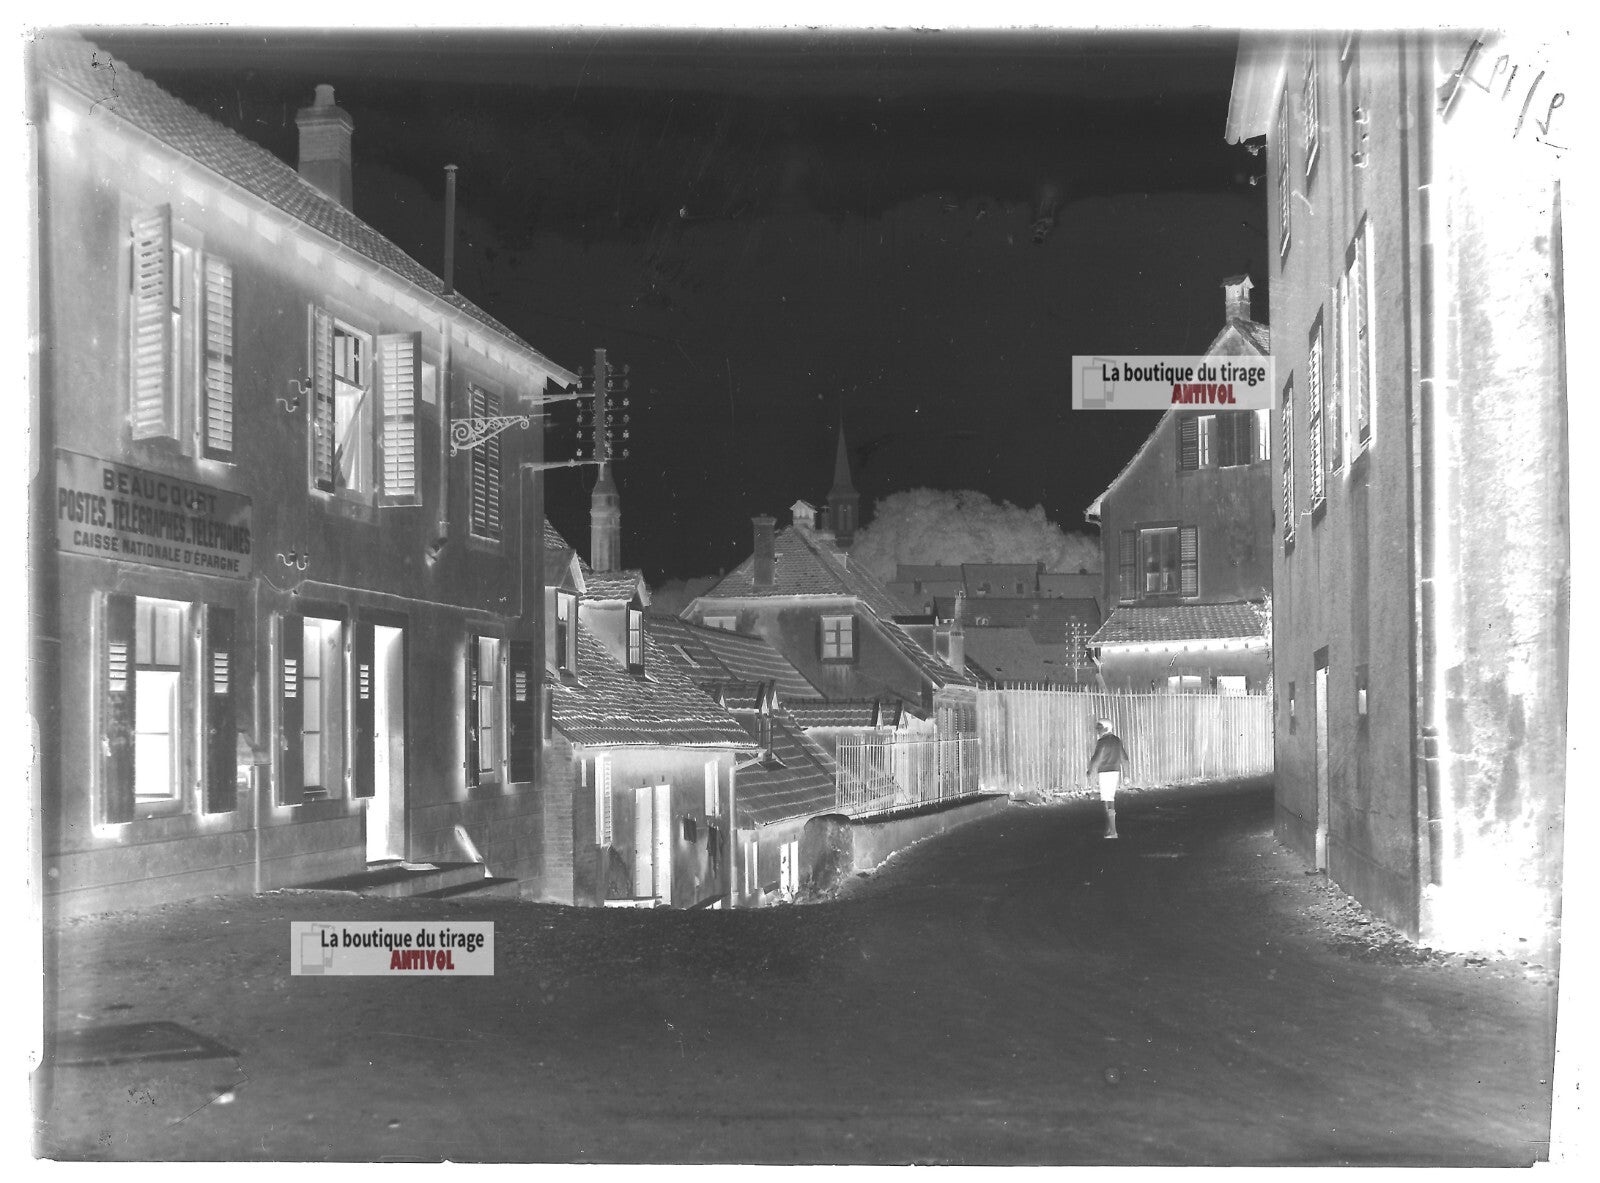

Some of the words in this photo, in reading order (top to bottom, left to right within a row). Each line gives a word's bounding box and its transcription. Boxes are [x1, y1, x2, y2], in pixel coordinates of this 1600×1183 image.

[103, 468, 217, 513] BEAUCOURT
[74, 530, 119, 552] CAISSE
[121, 539, 181, 563] NATIONALE
[184, 550, 240, 573] D'ÉPARGNE
